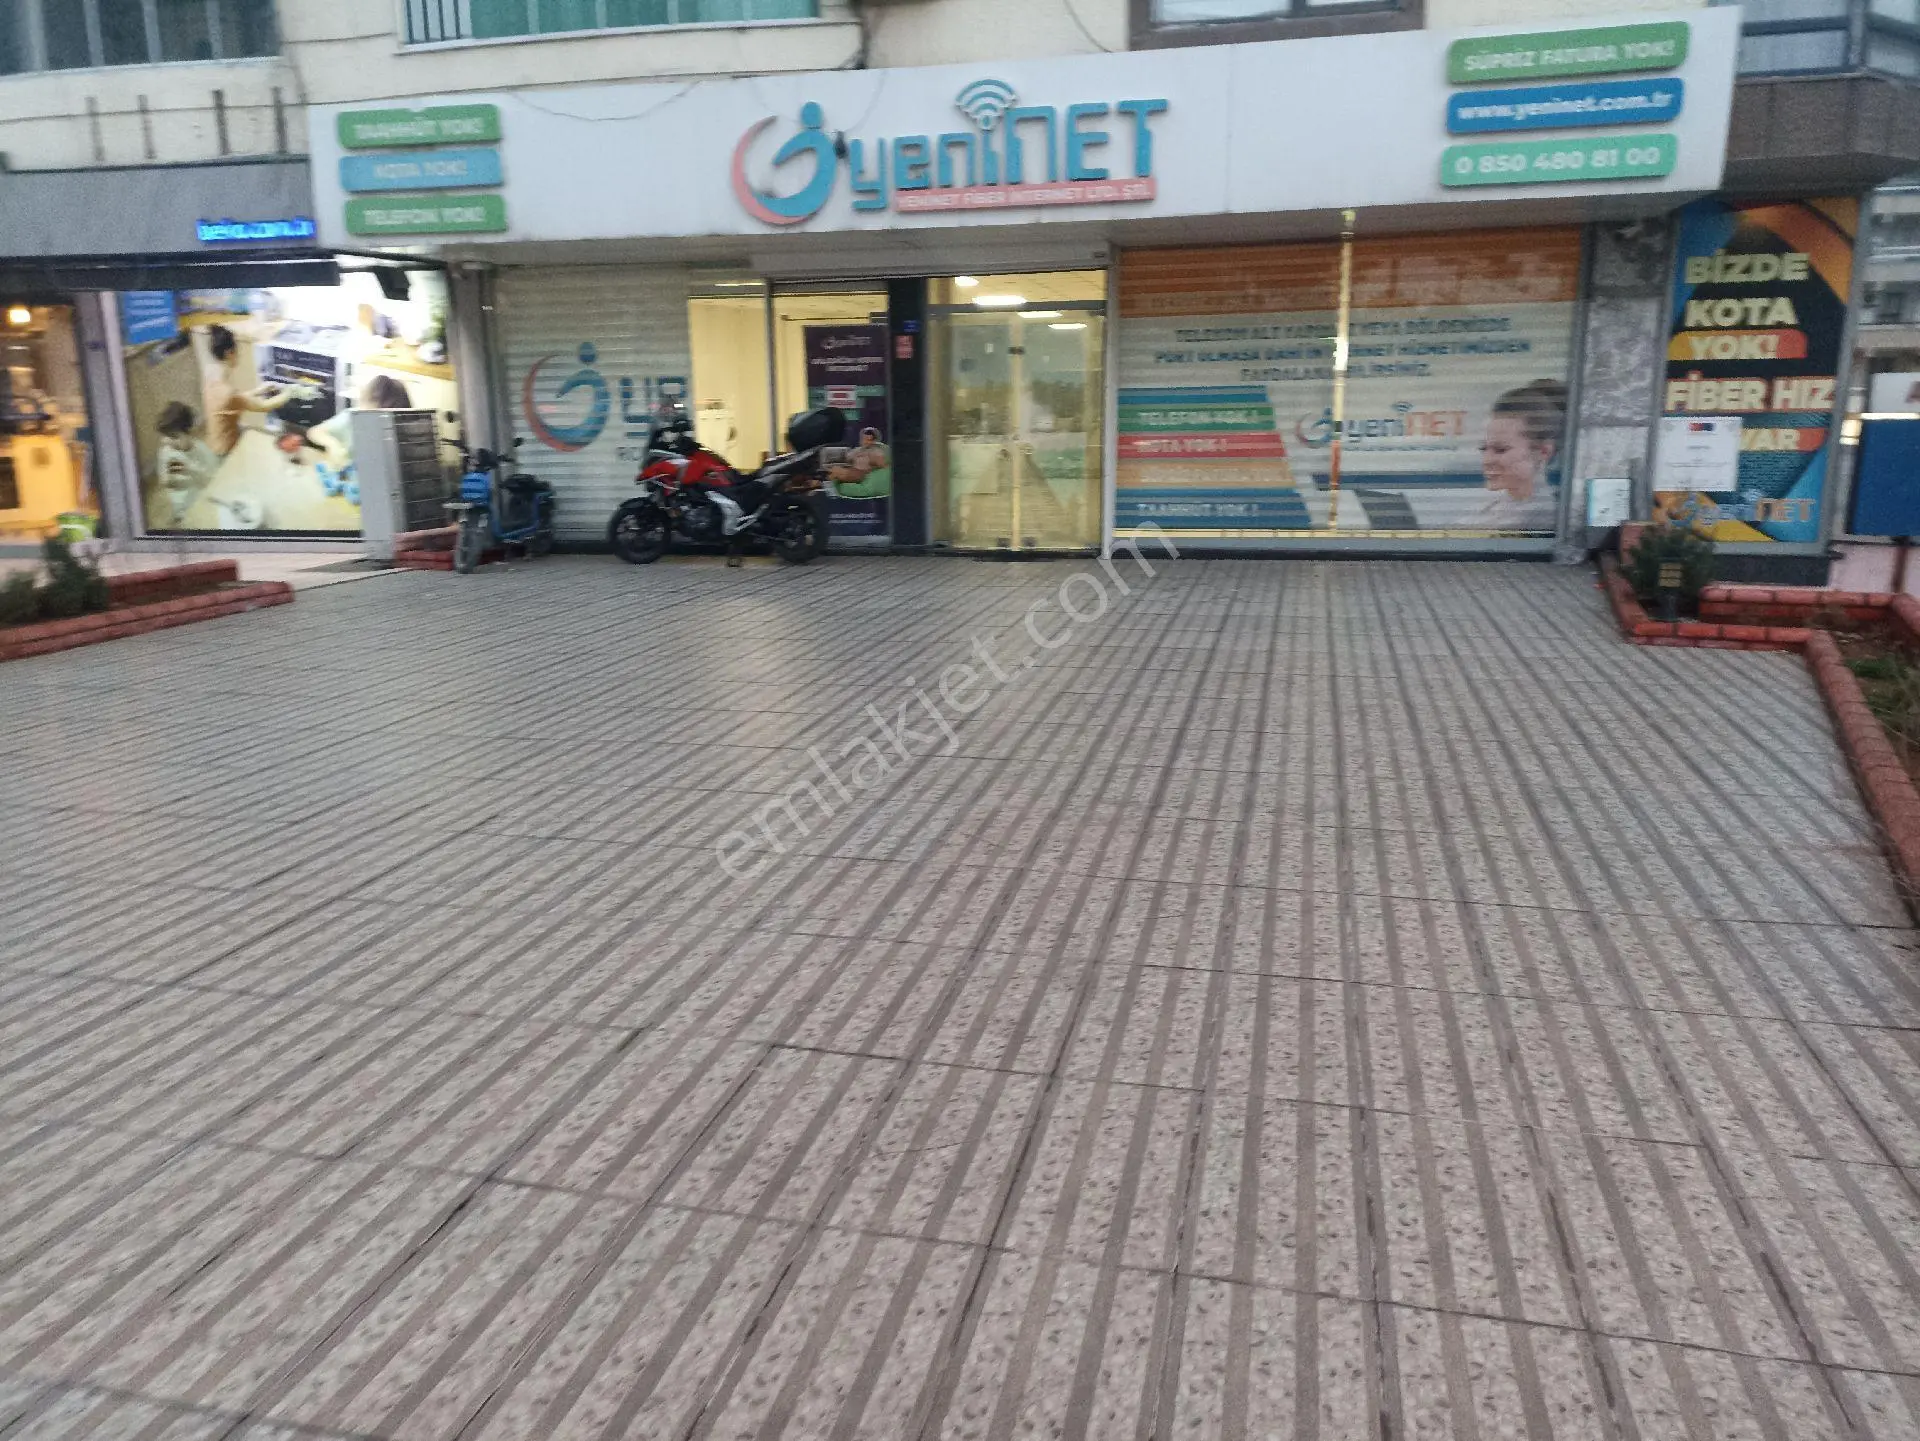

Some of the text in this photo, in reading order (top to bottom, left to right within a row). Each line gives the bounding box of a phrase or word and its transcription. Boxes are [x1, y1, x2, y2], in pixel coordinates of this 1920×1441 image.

[1539, 45, 1618, 66] FATURA
[1454, 146, 1661, 174] 0 850 480 81 00
[1684, 250, 1810, 284] BİZDE
[1684, 296, 1799, 327] KOTA
[1688, 335, 1780, 360] YOK!
[1665, 370, 1838, 411] FİBER HIZ
